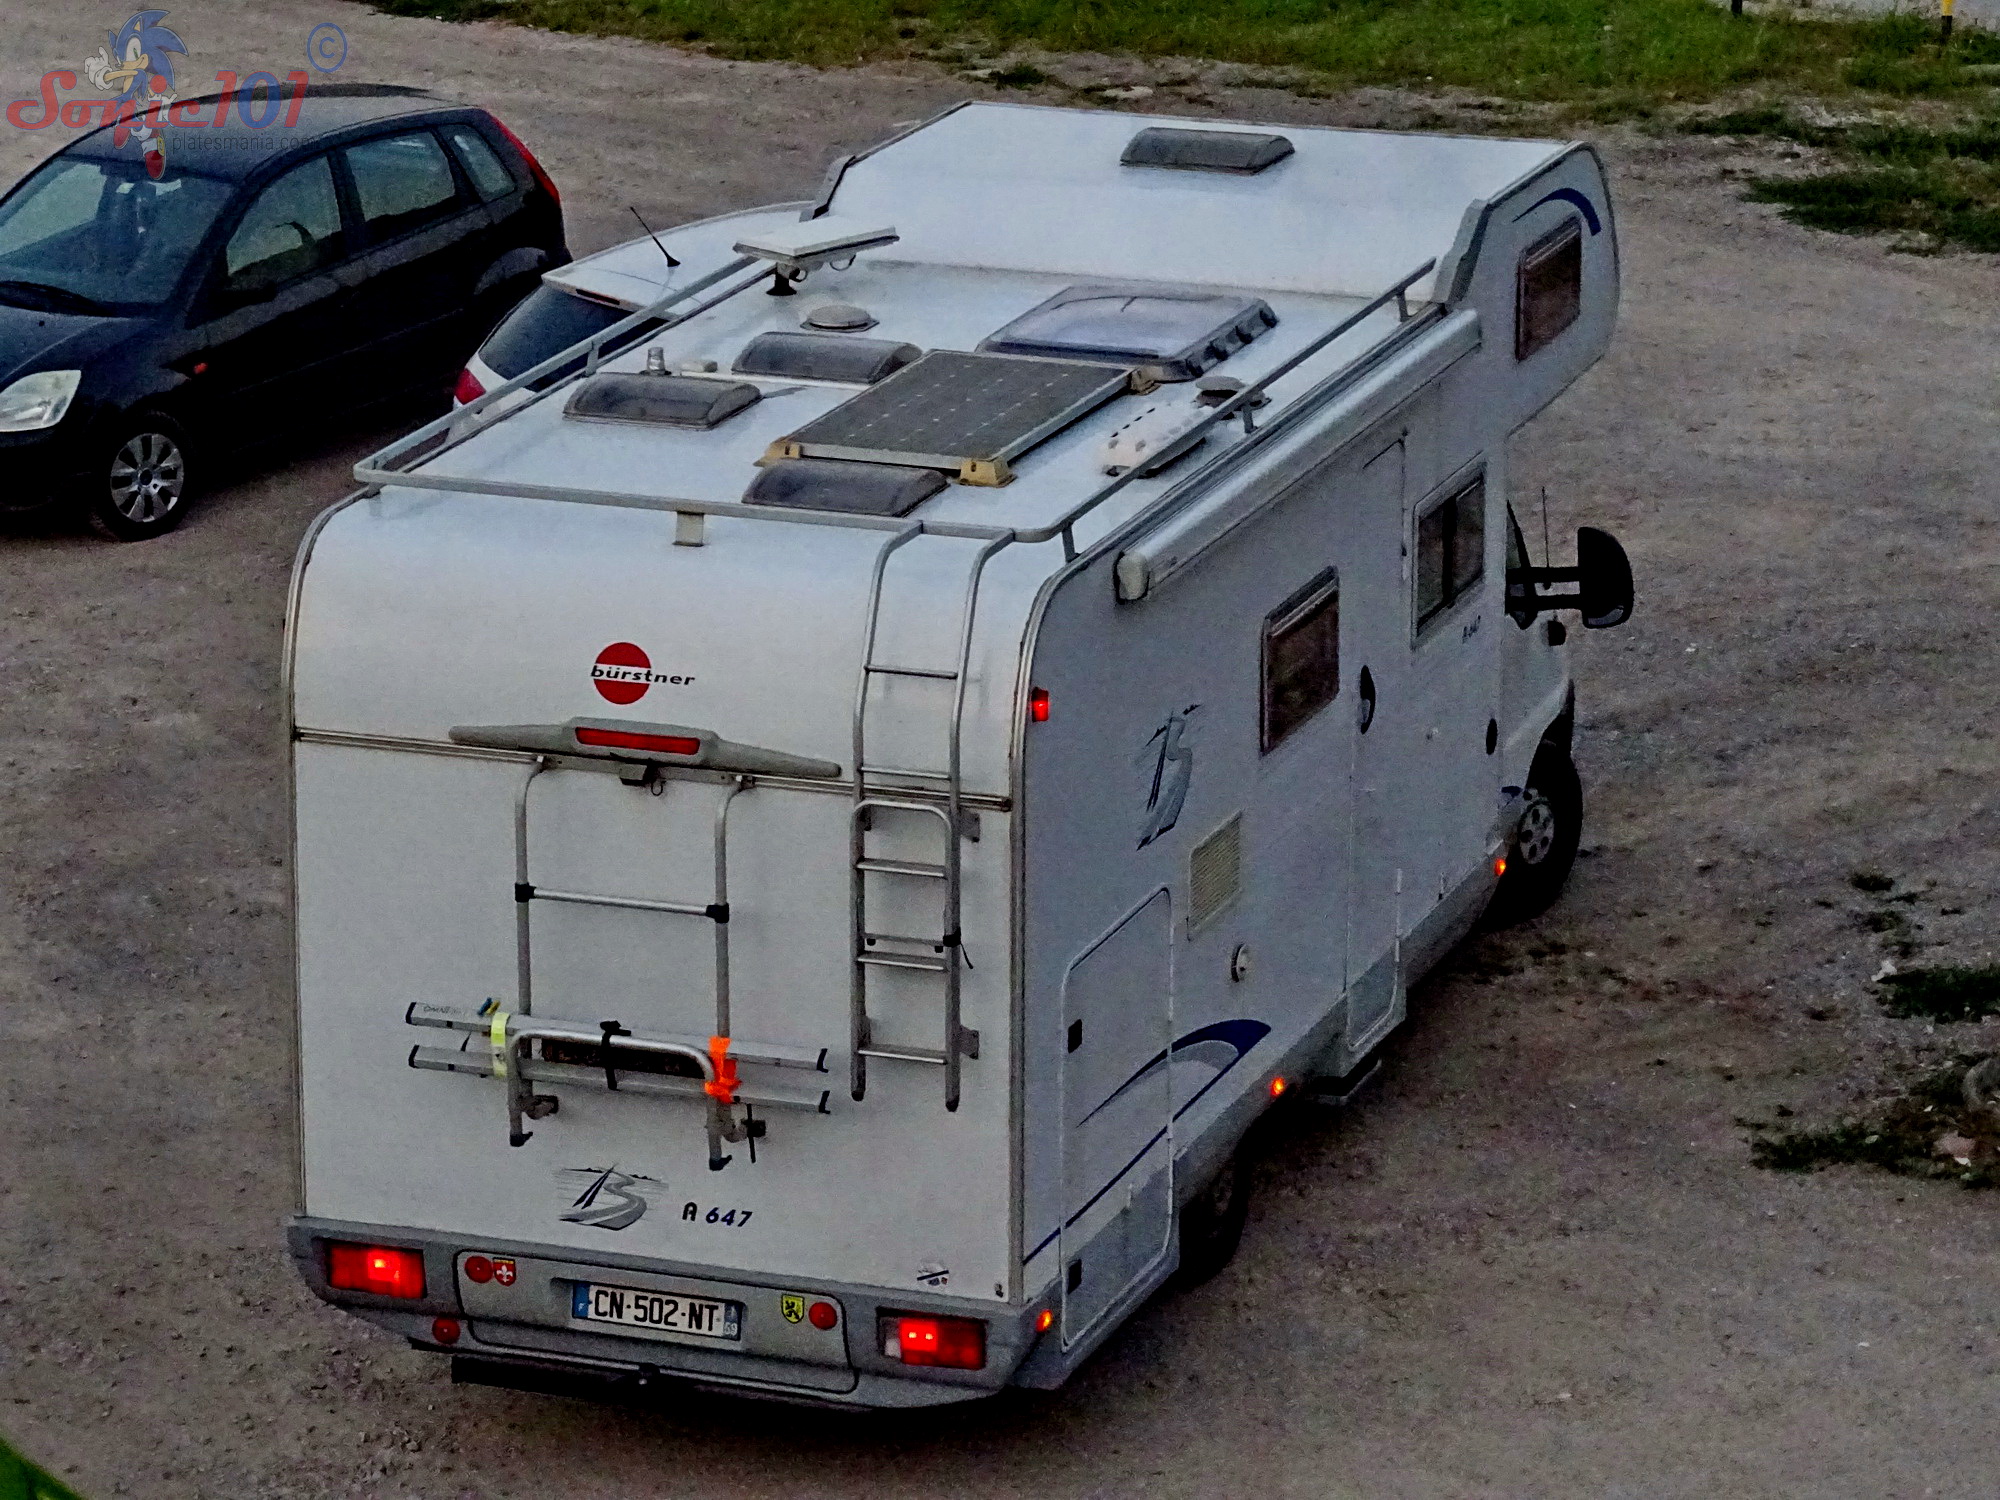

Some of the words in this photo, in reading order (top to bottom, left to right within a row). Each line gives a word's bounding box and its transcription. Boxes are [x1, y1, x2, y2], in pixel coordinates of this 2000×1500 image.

[590, 665, 696, 685] bürstner
[682, 1201, 698, 1222] A
[706, 1206, 753, 1228] 647
